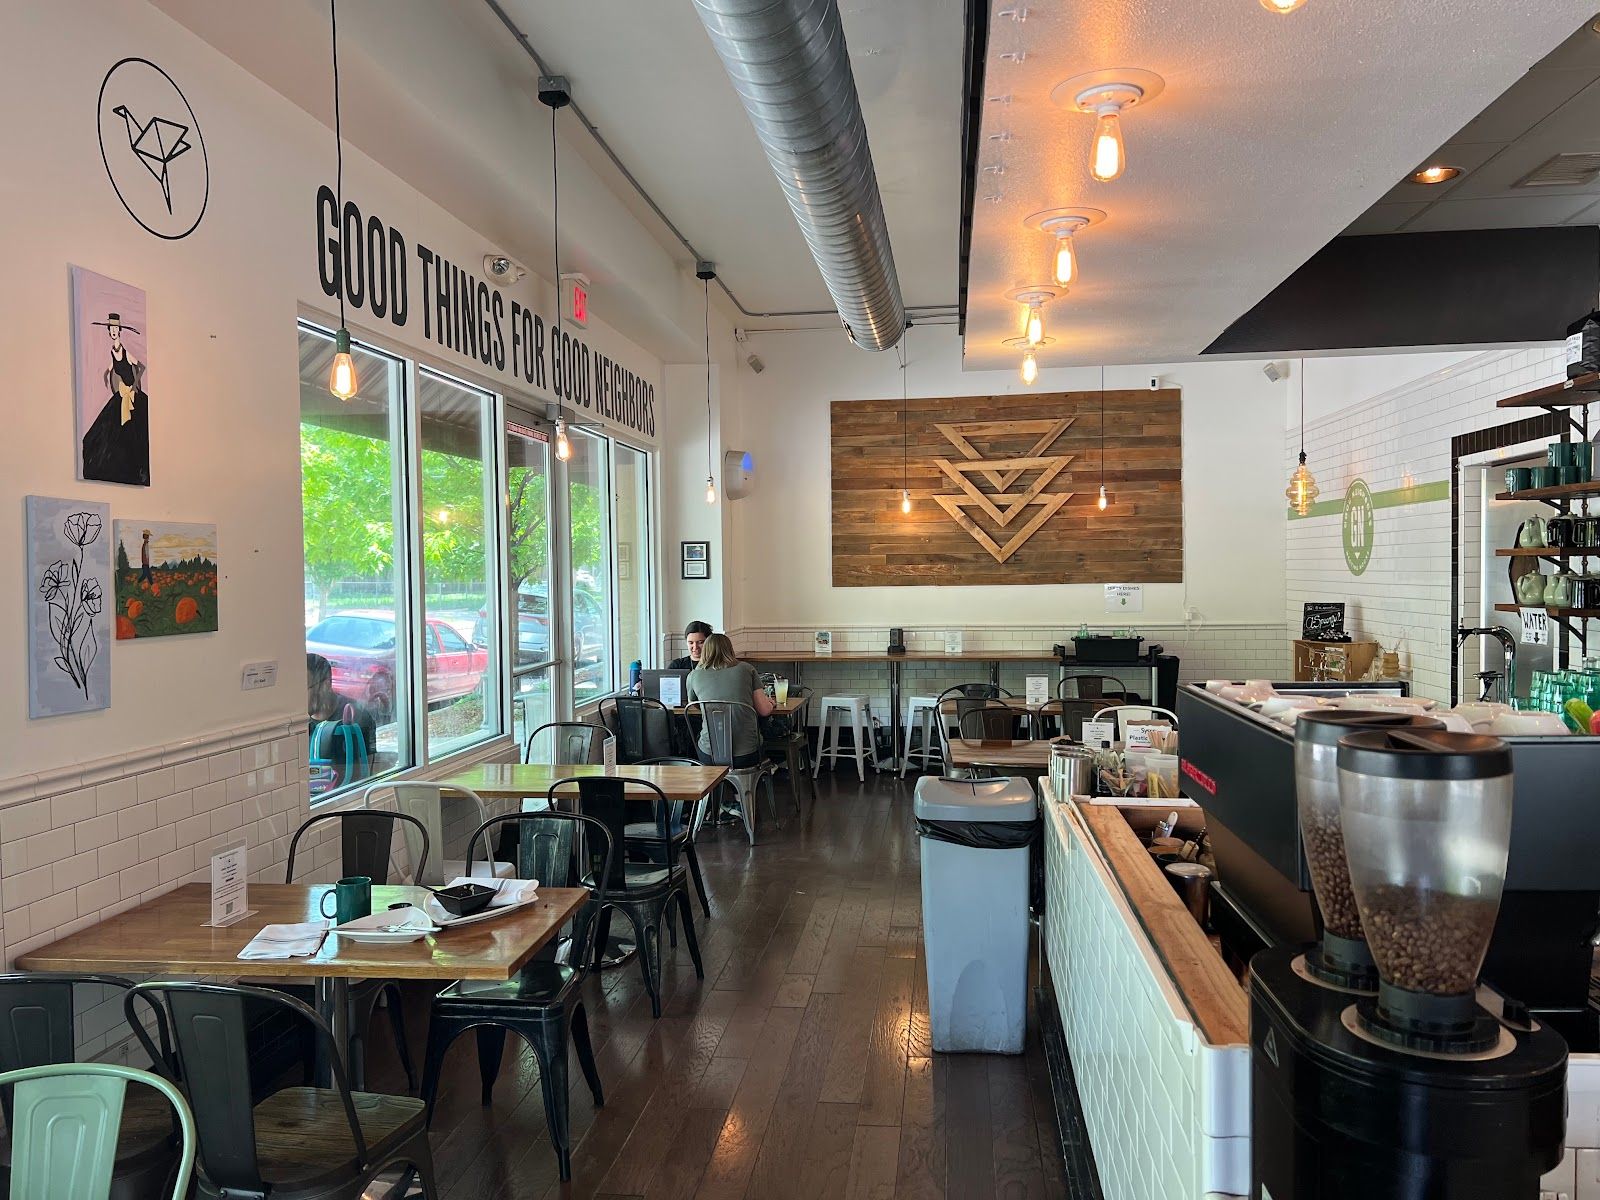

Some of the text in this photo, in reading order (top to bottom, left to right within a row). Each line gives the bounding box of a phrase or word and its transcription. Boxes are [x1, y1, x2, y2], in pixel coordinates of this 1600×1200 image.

[316, 185, 656, 438] GOOD THINGS FOR GOOD NEIGHBORS
[1350, 505, 1365, 548] GN
[1522, 612, 1547, 631] WATER
